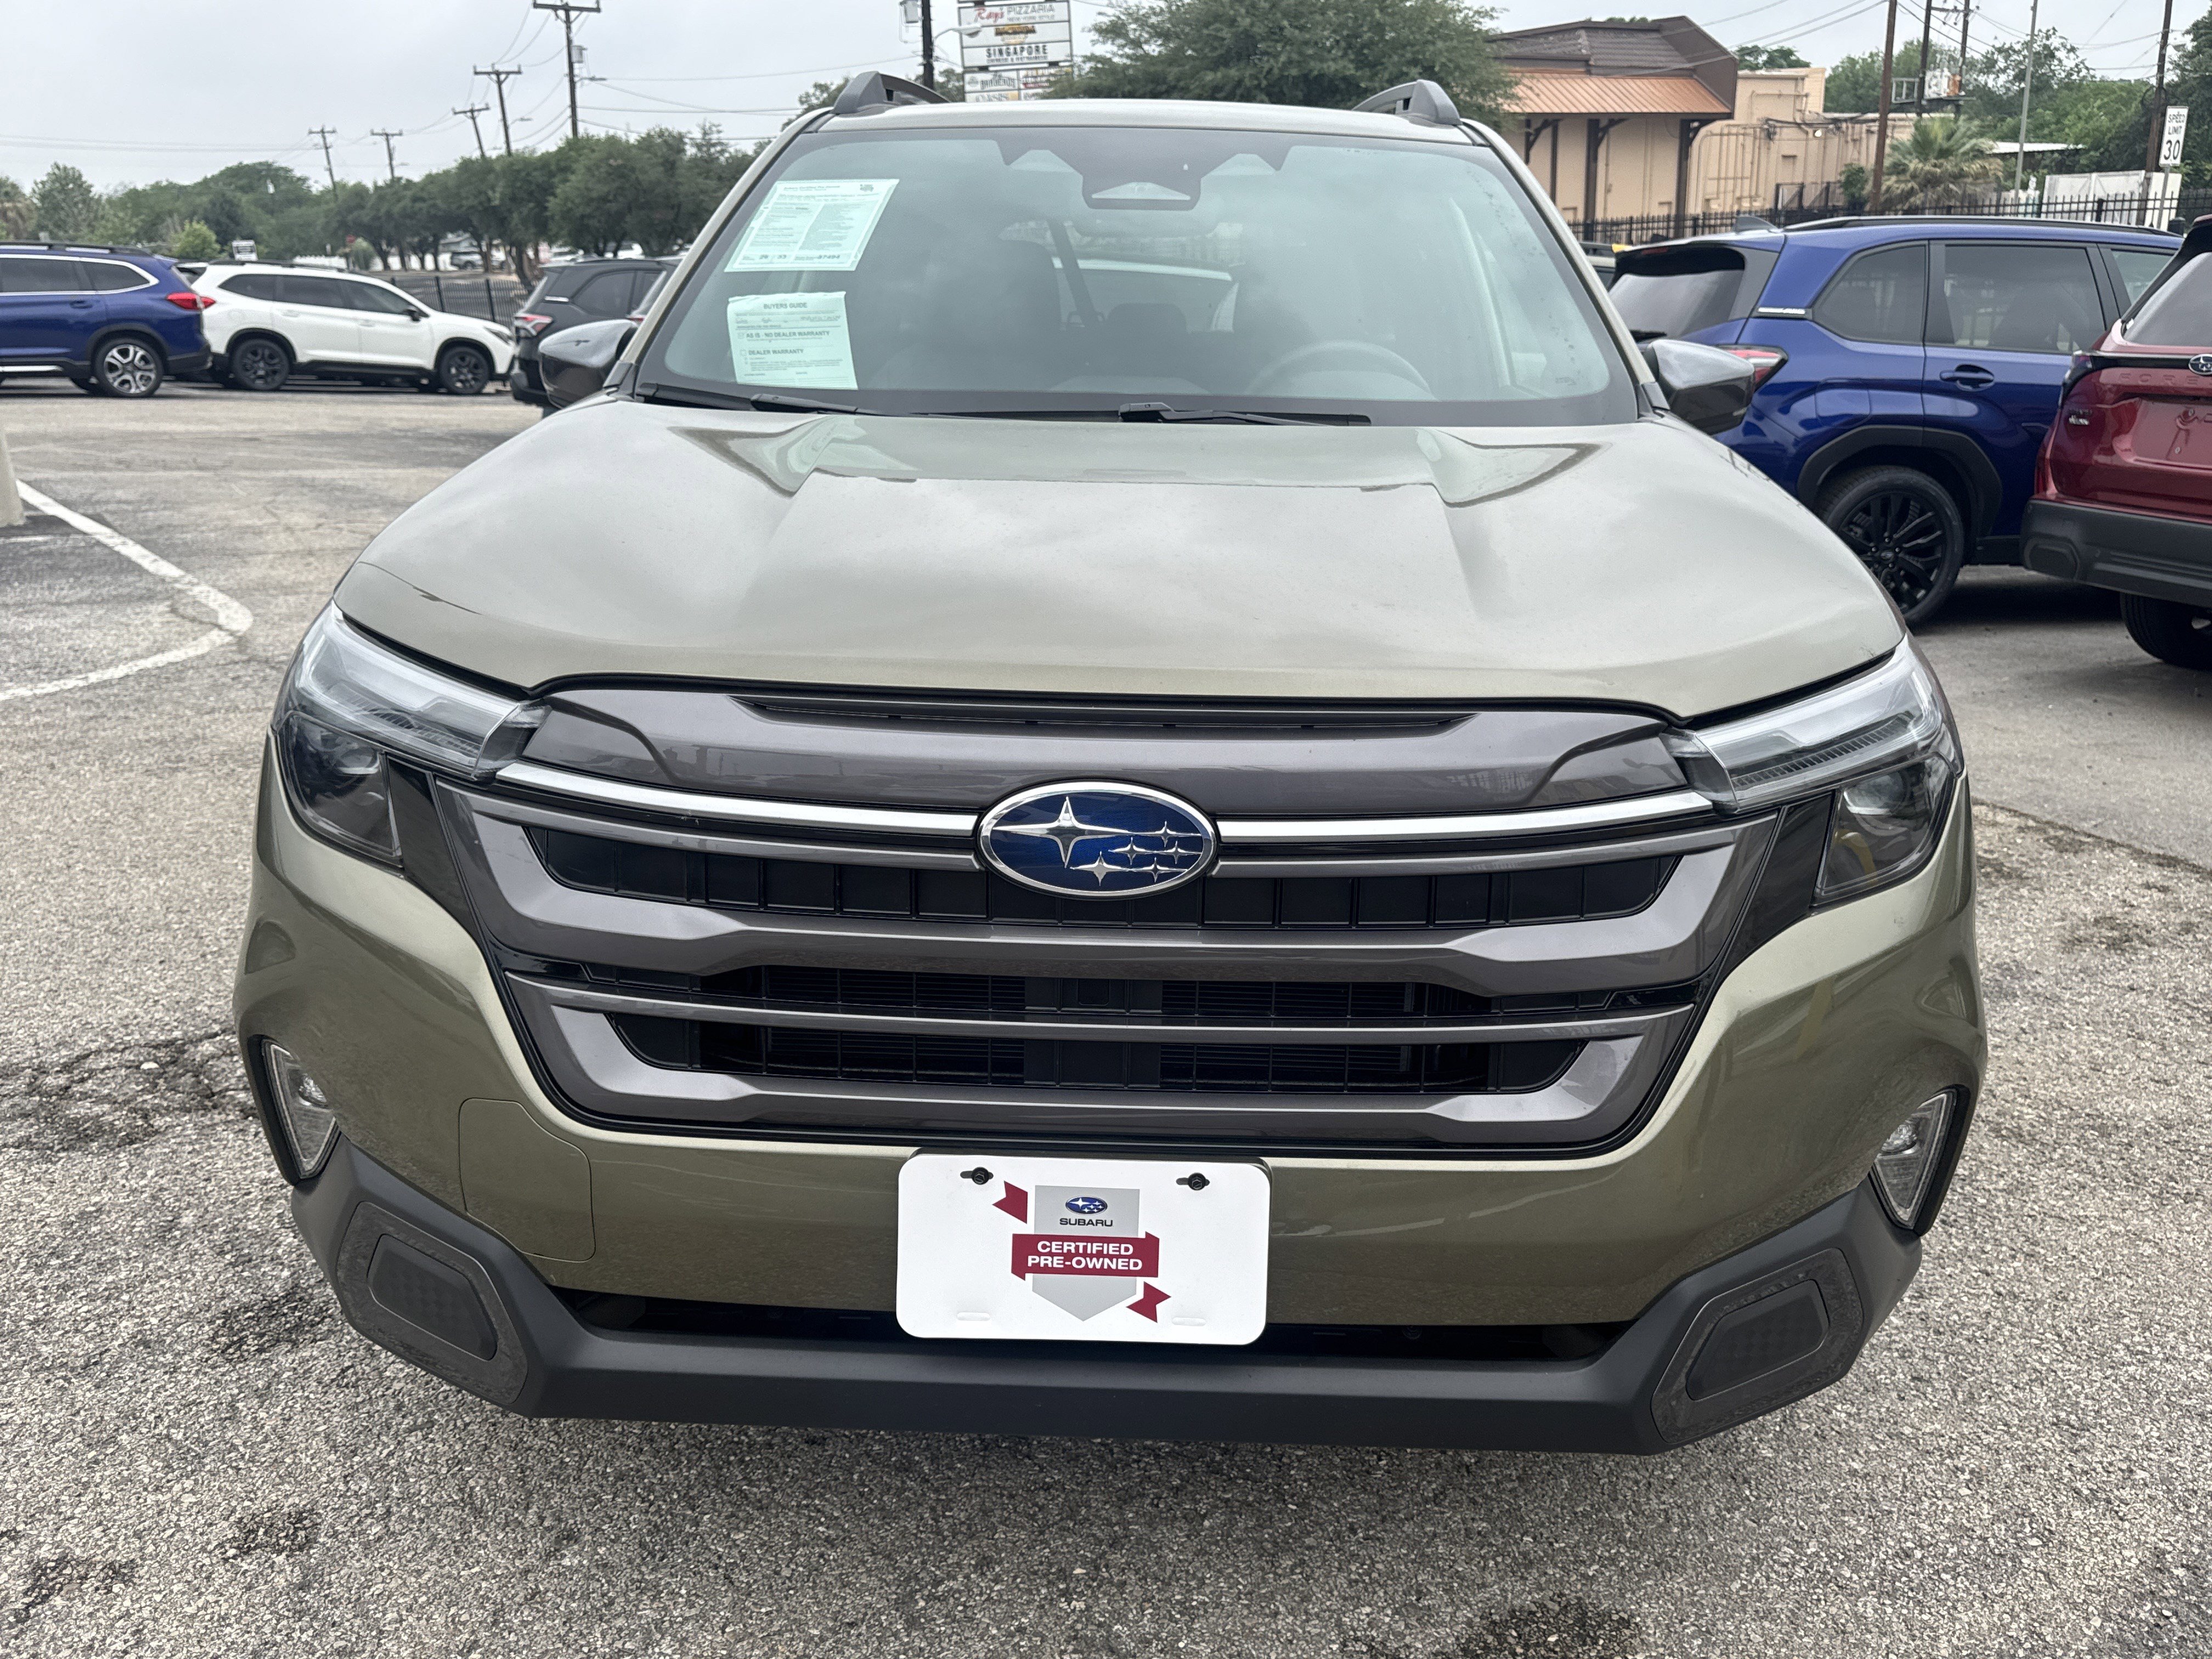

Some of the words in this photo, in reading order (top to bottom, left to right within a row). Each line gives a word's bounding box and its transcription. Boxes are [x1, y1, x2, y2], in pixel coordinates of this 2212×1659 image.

[1007, 4, 1055, 15] PIZZARIA
[986, 44, 1048, 58] SINGAPORE
[2168, 113, 2186, 123] SPEED
[2168, 125, 2182, 136] LIMIT
[2163, 139, 2181, 160] 30
[1059, 1217, 1114, 1227] SUBARU
[1037, 1240, 1134, 1256] CERTIFIED
[1027, 1255, 1143, 1271] PRE-OWNED
